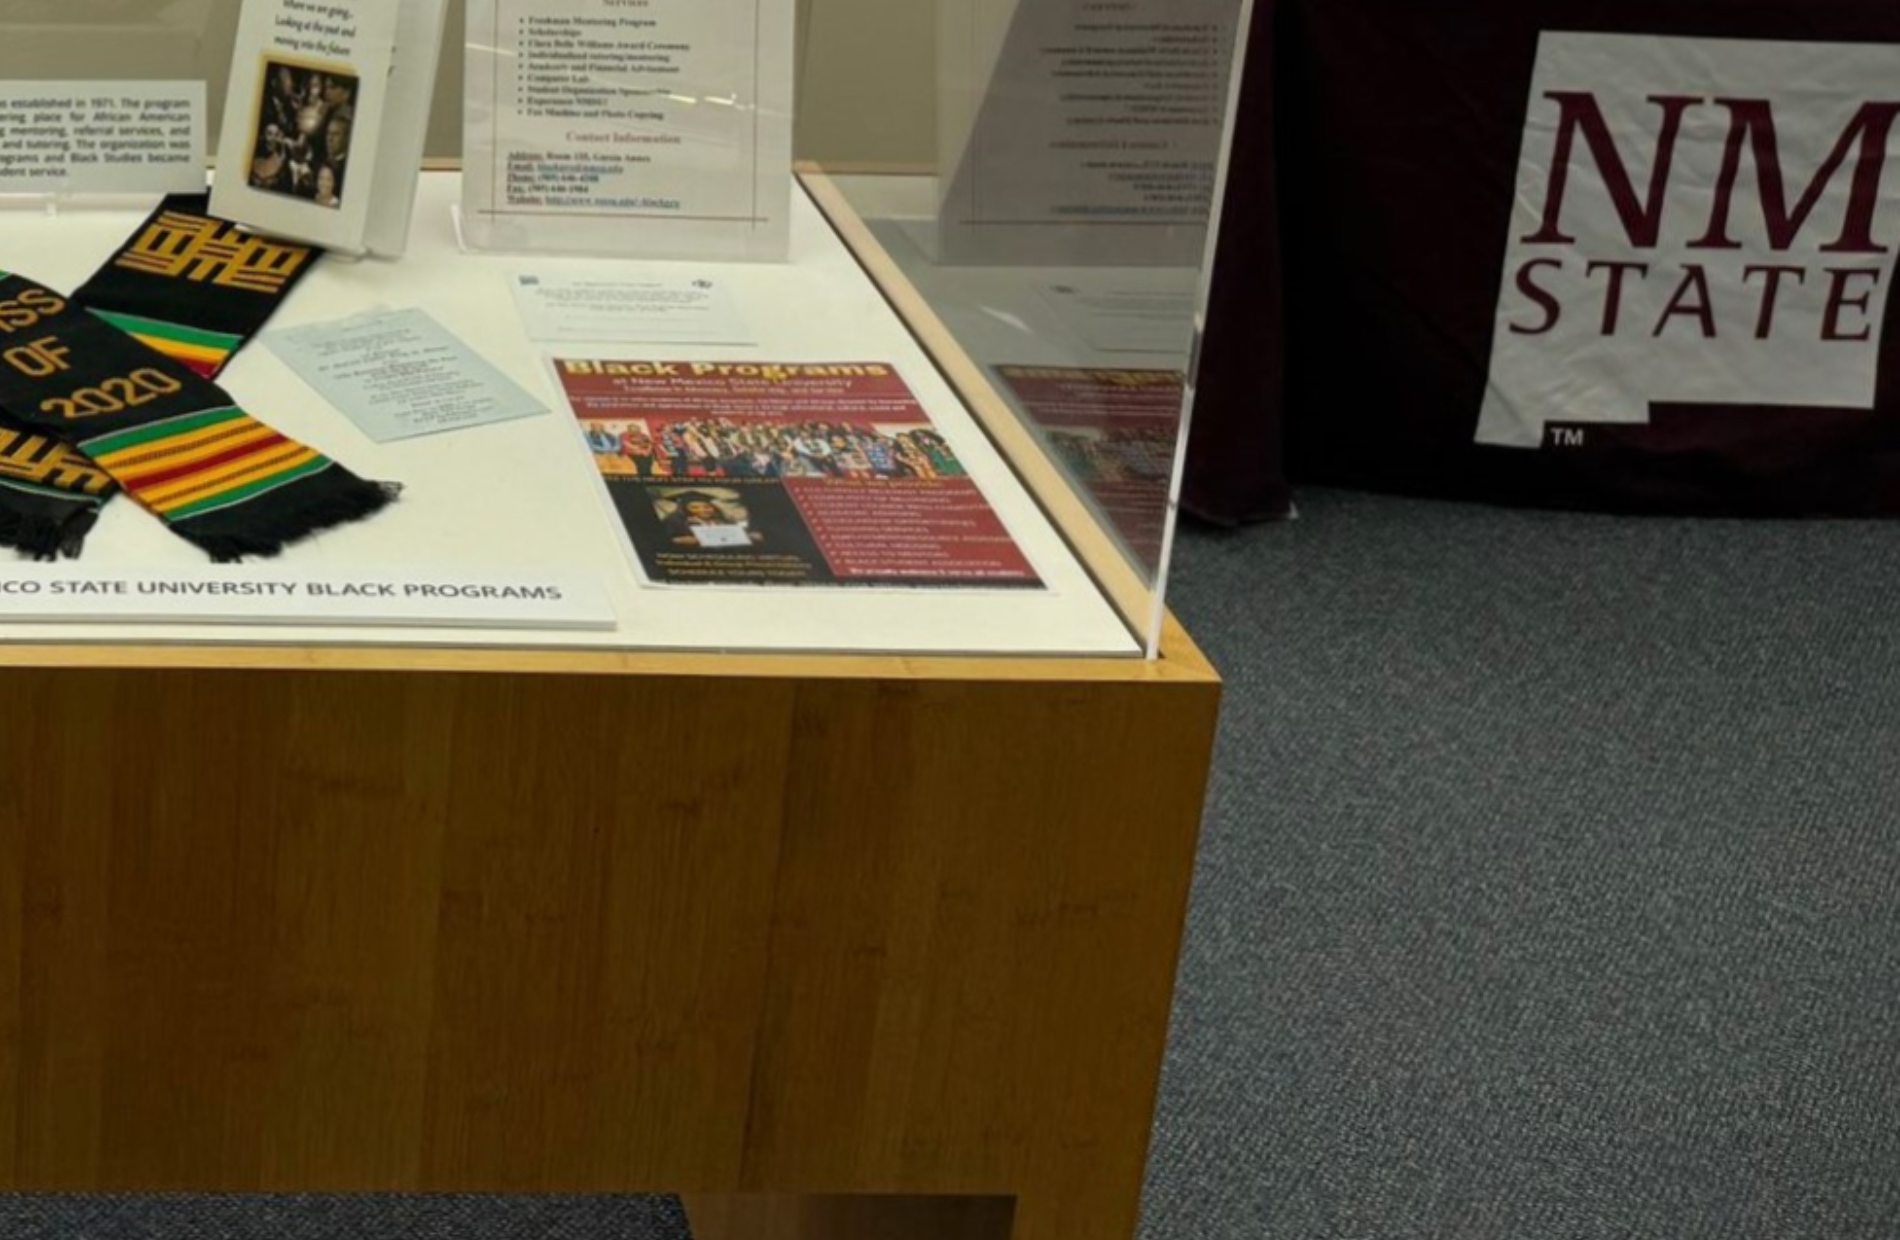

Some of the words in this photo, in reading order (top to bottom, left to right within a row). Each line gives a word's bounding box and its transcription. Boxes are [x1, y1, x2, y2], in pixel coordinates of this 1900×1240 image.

[275, 15, 303, 32] Looking
[304, 22, 311, 31] at
[313, 21, 323, 32] the
[325, 25, 339, 35] past
[341, 27, 356, 37] and
[528, 16, 571, 26] Freshman
[573, 16, 617, 28] Mentoring
[619, 17, 657, 28] Program
[274, 36, 299, 50] moving
[316, 41, 326, 51] the
[617, 41, 645, 51] Award
[10, 97, 72, 109] established
[75, 97, 86, 109] in
[120, 97, 140, 109] The
[144, 100, 191, 111] program
[33, 111, 62, 125] place
[69, 111, 85, 122] for
[93, 111, 132, 122] African
[138, 111, 191, 122] American
[10, 125, 67, 138] mentoring,
[73, 125, 114, 136] referral
[118, 125, 164, 138] services,
[169, 125, 191, 136] and
[566, 131, 609, 143] Contact
[613, 132, 681, 145] Information
[2, 138, 23, 149] and
[26, 138, 71, 152] tutoring.
[76, 138, 96, 149] The
[100, 138, 165, 152] organization
[169, 141, 191, 149] was
[44, 152, 64, 163] and
[70, 152, 99, 163] Black
[104, 152, 143, 163] Studies
[147, 152, 191, 163] became
[29, 165, 68, 176] service.
[1520, 91, 1900, 252] NM
[1508, 257, 1881, 341] STATE
[2, 337, 73, 379] OF
[564, 360, 678, 376] Black
[690, 362, 888, 382] Programs
[631, 378, 666, 386] New
[670, 378, 726, 387] Mexico
[728, 378, 772, 387] State
[39, 367, 182, 420] 2020
[1550, 427, 1584, 446] TM
[48, 579, 129, 596] STATE
[136, 580, 298, 597] UNIVERSITY
[306, 581, 396, 598] BLACK
[403, 583, 563, 601] PROGRAMS
